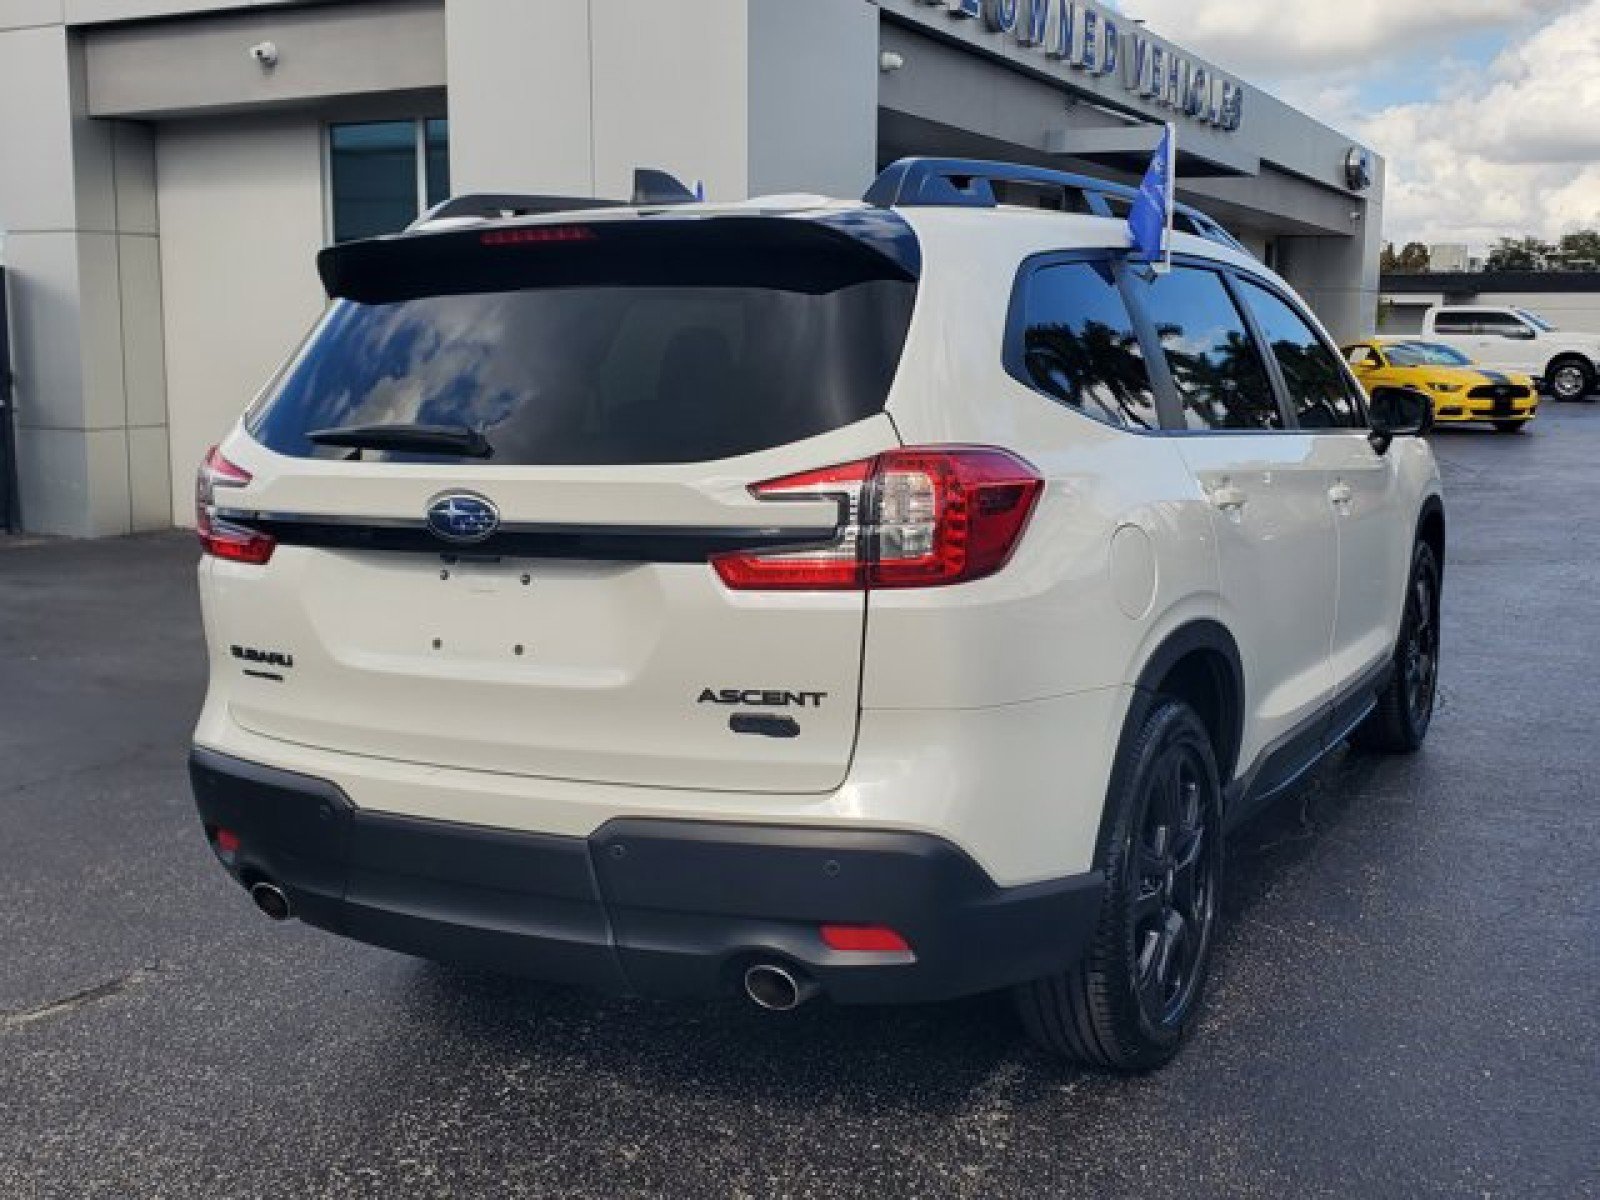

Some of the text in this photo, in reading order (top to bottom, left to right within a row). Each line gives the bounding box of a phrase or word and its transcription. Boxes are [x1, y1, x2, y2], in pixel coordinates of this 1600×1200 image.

[1123, 34, 1243, 130] VEHICLES
[230, 644, 293, 668] SUBARU
[697, 687, 828, 707] ASCENT
